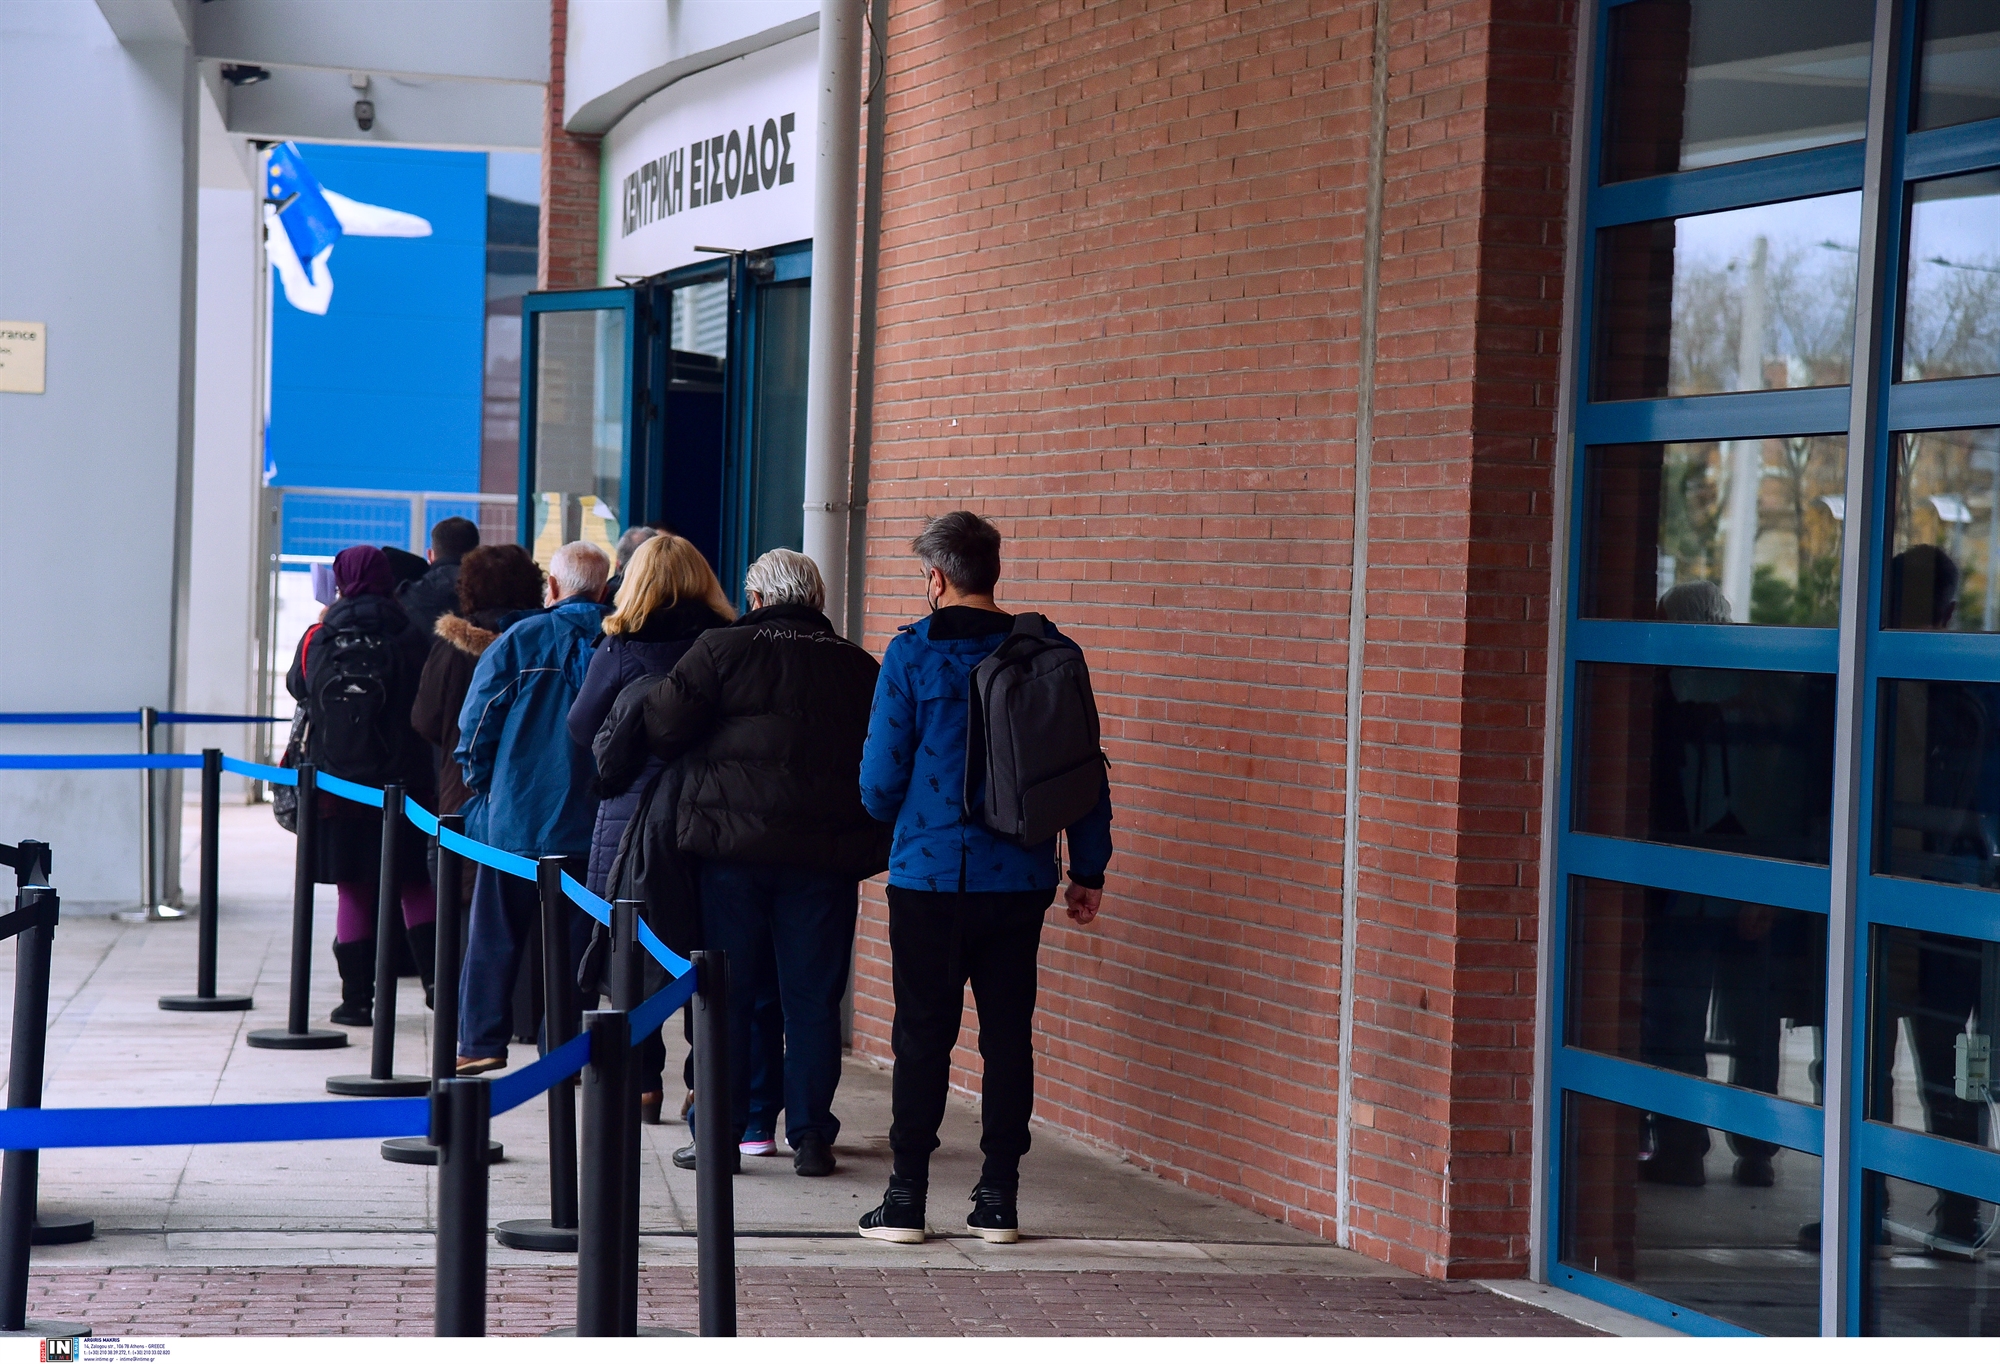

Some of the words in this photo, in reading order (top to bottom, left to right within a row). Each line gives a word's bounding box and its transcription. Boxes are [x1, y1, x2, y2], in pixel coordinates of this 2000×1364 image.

[622, 147, 684, 239] ΚΕΝΤΡΙΚΗ
[690, 112, 795, 209] ΕΙΣΟΔΟΣ
[0, 330, 36, 341] rance
[753, 628, 797, 642] MAUI
